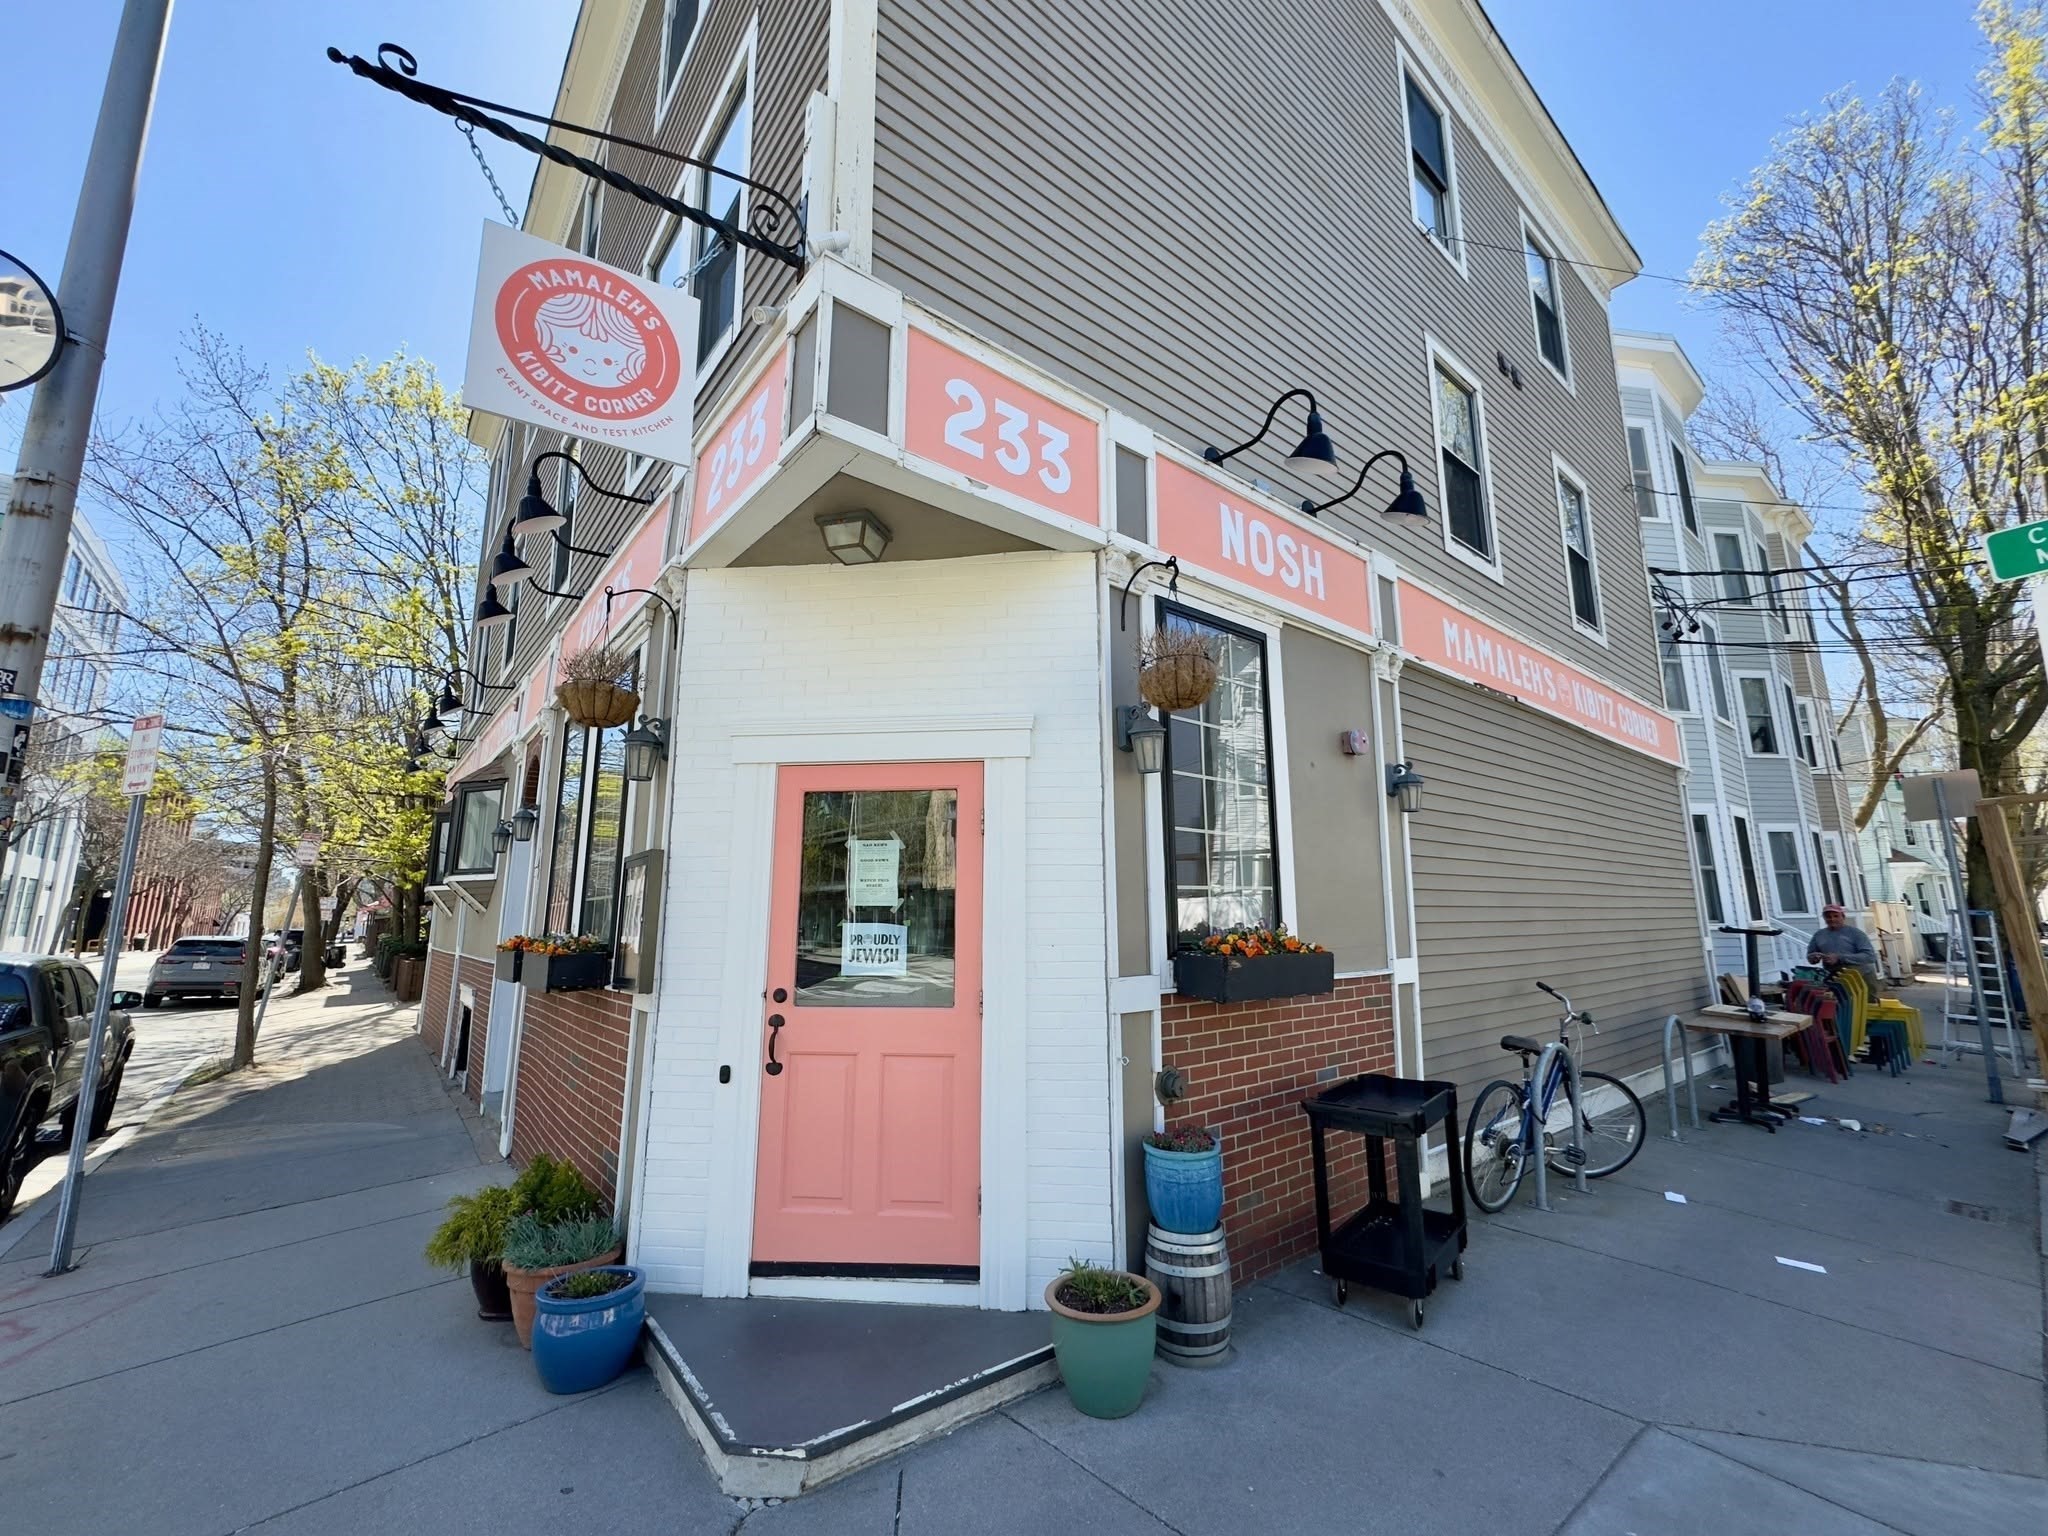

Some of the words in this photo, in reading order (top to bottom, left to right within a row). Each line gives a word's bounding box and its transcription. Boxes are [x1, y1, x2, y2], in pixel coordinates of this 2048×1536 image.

[527, 268, 661, 331] MAMALEH'S
[496, 366, 530, 399] EVENT
[530, 399, 568, 425] SPACE
[571, 421, 598, 435] AND
[602, 428, 627, 438] TEST
[631, 415, 674, 437] KITCHEN
[516, 350, 579, 405] KIBITZ
[584, 387, 657, 414] CORNER
[706, 385, 769, 515] 233
[944, 378, 1072, 494] 233
[1219, 501, 1326, 601] NOSH
[1442, 617, 1557, 701] MAMALEH'S
[1571, 679, 1617, 729] KIBITZ
[1617, 702, 1659, 748] CORNER
[849, 948, 899, 964] JEWISH
